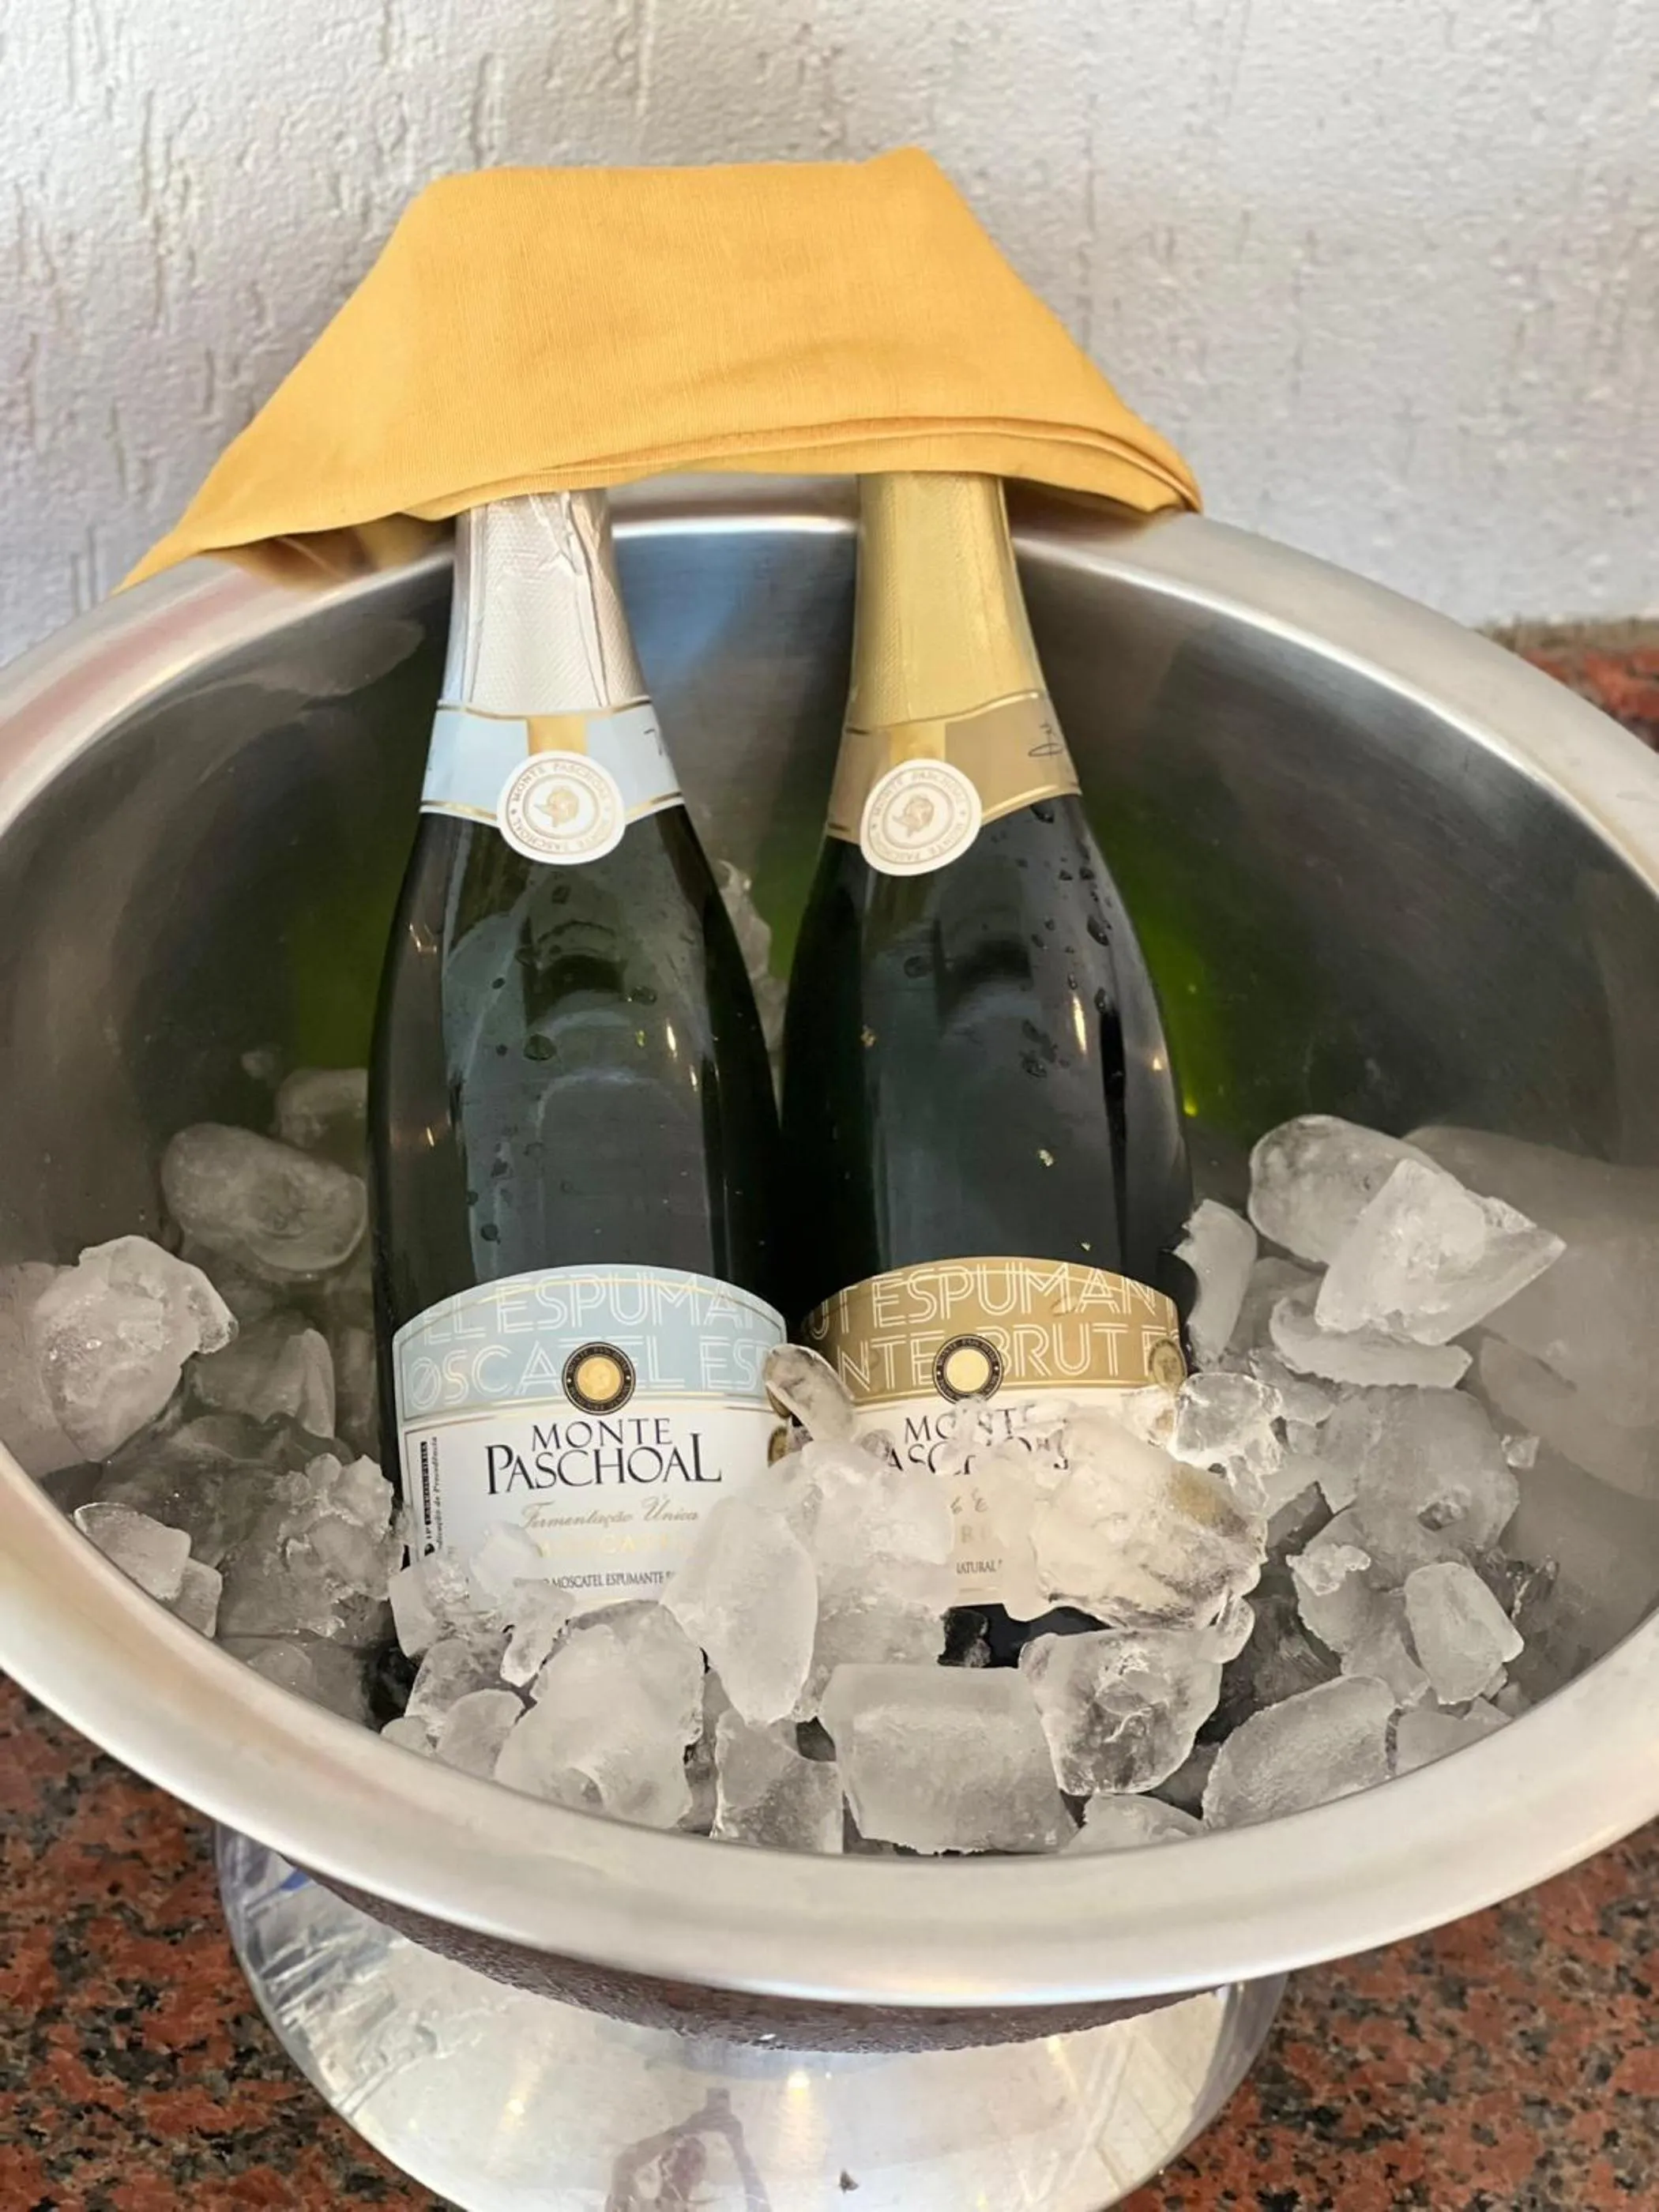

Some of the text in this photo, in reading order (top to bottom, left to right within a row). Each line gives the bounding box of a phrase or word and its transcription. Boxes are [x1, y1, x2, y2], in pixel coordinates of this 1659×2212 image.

[531, 1417, 673, 1452] MONTE
[484, 1431, 723, 1495] PASCHOAL
[521, 1493, 699, 1530] Fermentação Única
[605, 1571, 664, 1586] ESPUMANTE
